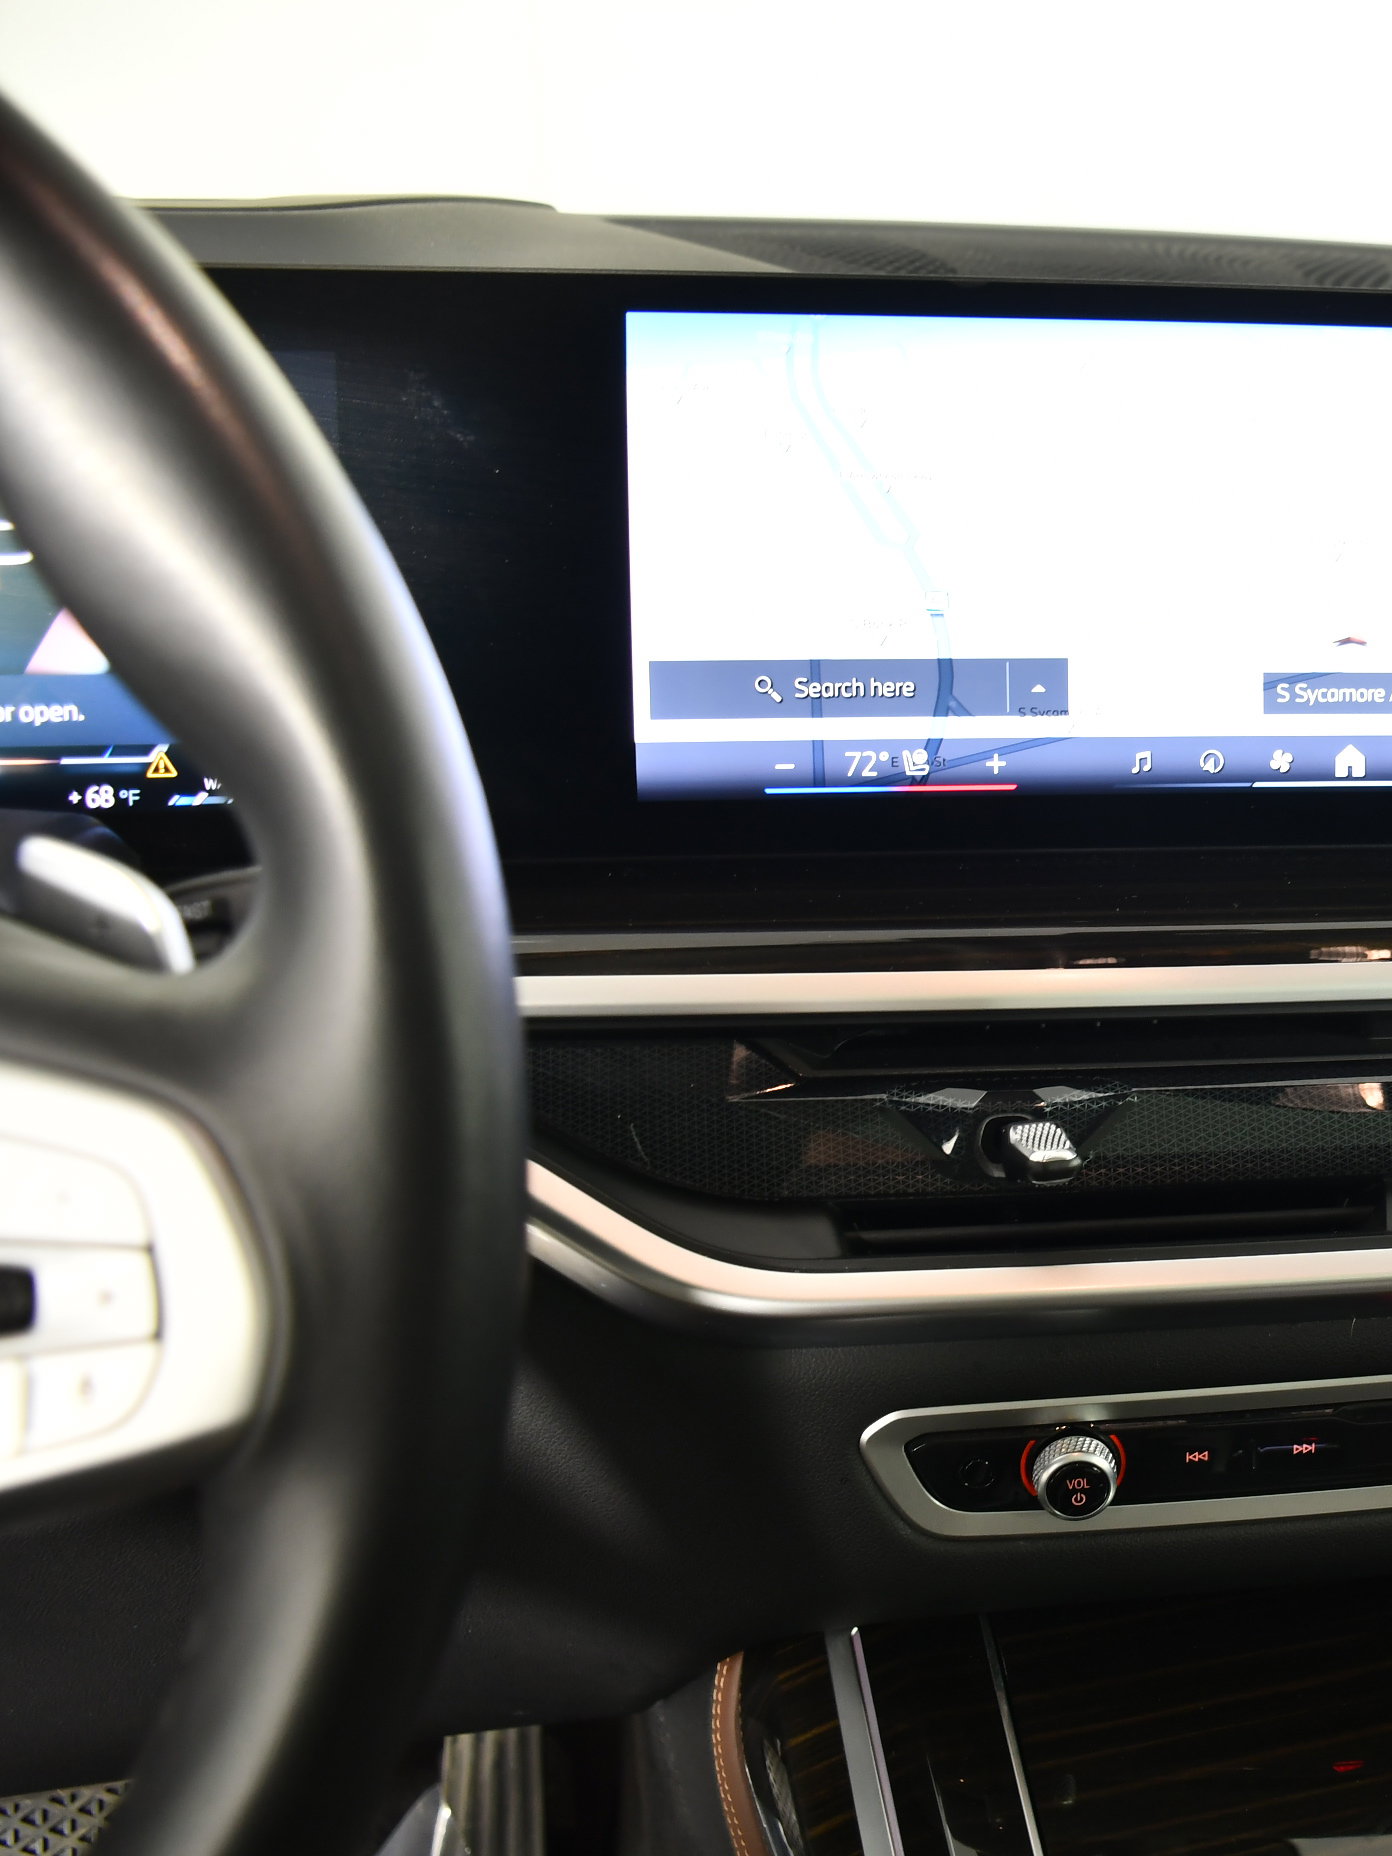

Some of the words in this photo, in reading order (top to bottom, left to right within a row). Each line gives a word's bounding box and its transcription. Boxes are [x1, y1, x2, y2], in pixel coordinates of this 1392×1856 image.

[794, 677, 865, 699] Search
[869, 676, 916, 698] here
[1276, 683, 1290, 703] S
[1294, 683, 1386, 707] Sycamore
[18, 703, 86, 727] open.
[1066, 1478, 1091, 1490] VOL
